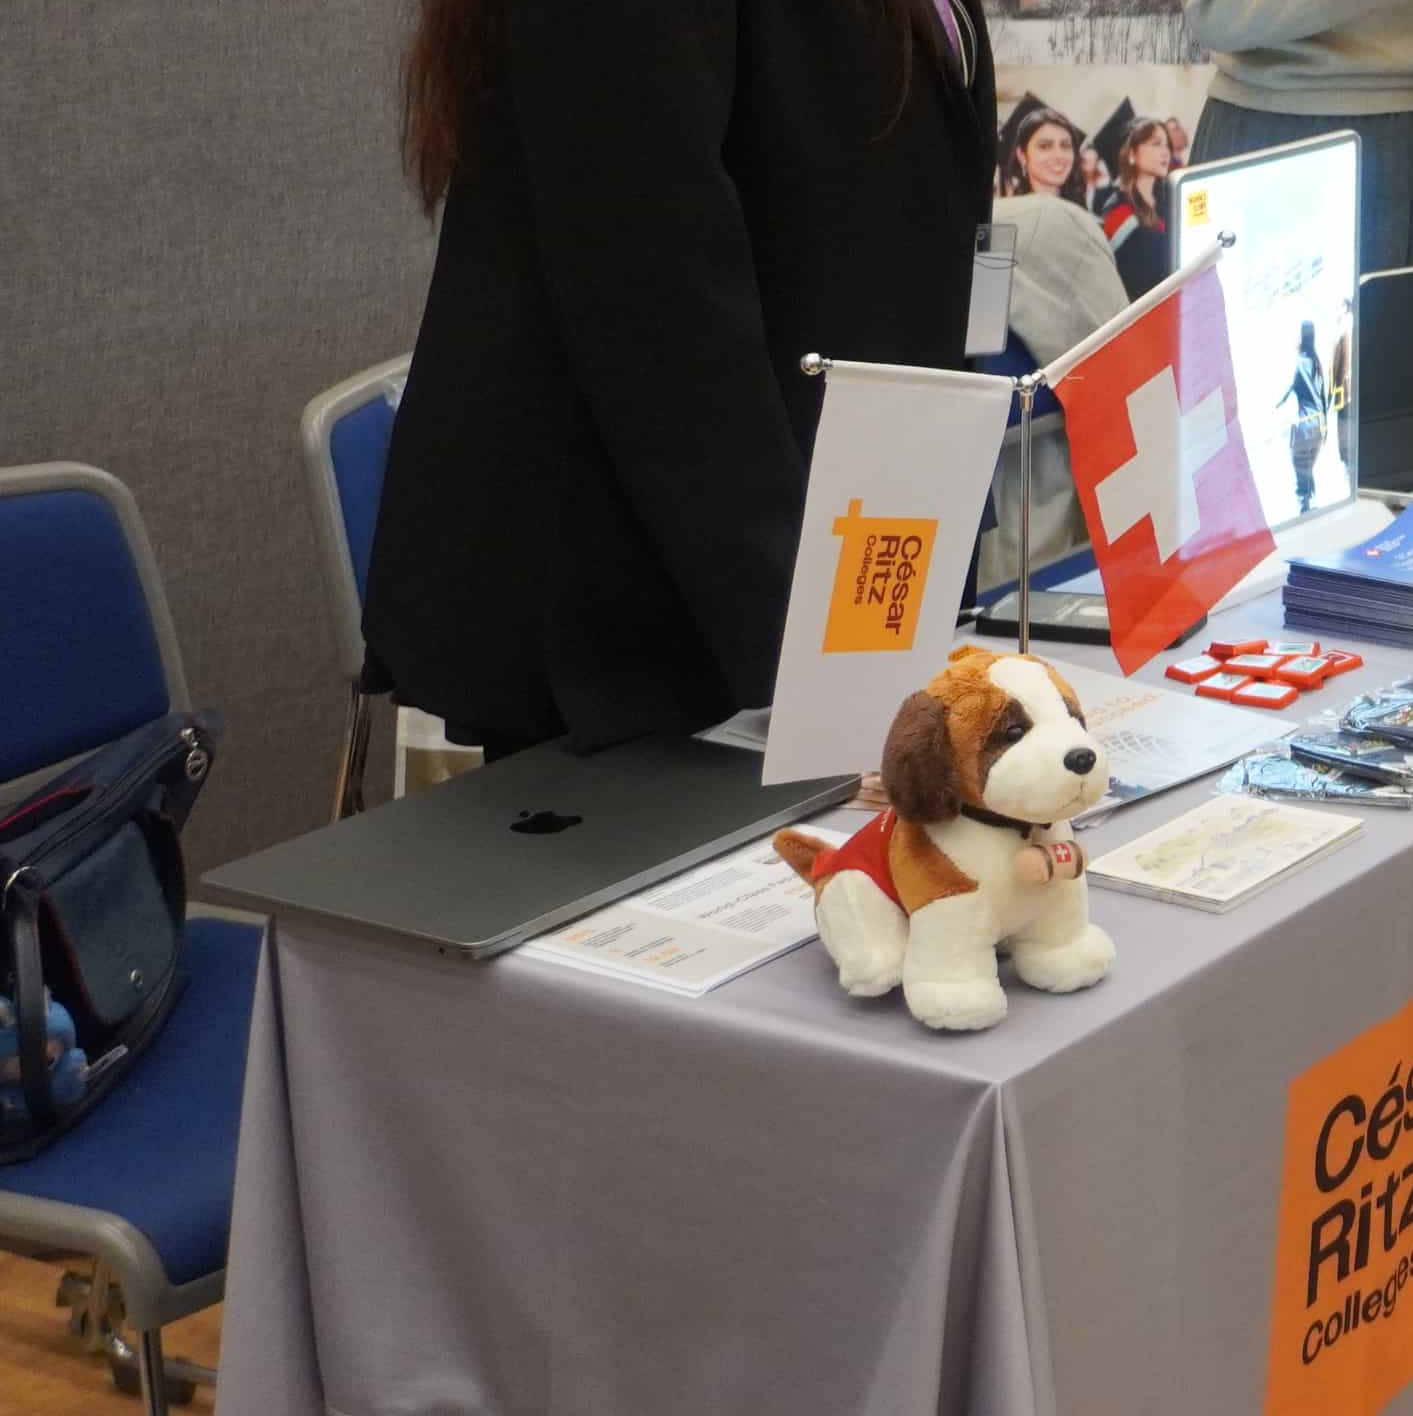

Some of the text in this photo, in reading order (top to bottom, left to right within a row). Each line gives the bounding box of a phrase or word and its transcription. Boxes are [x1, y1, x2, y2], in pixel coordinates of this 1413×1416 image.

[854, 534, 877, 605] Colleges
[867, 535, 902, 606] Ritz
[885, 535, 923, 636] César
